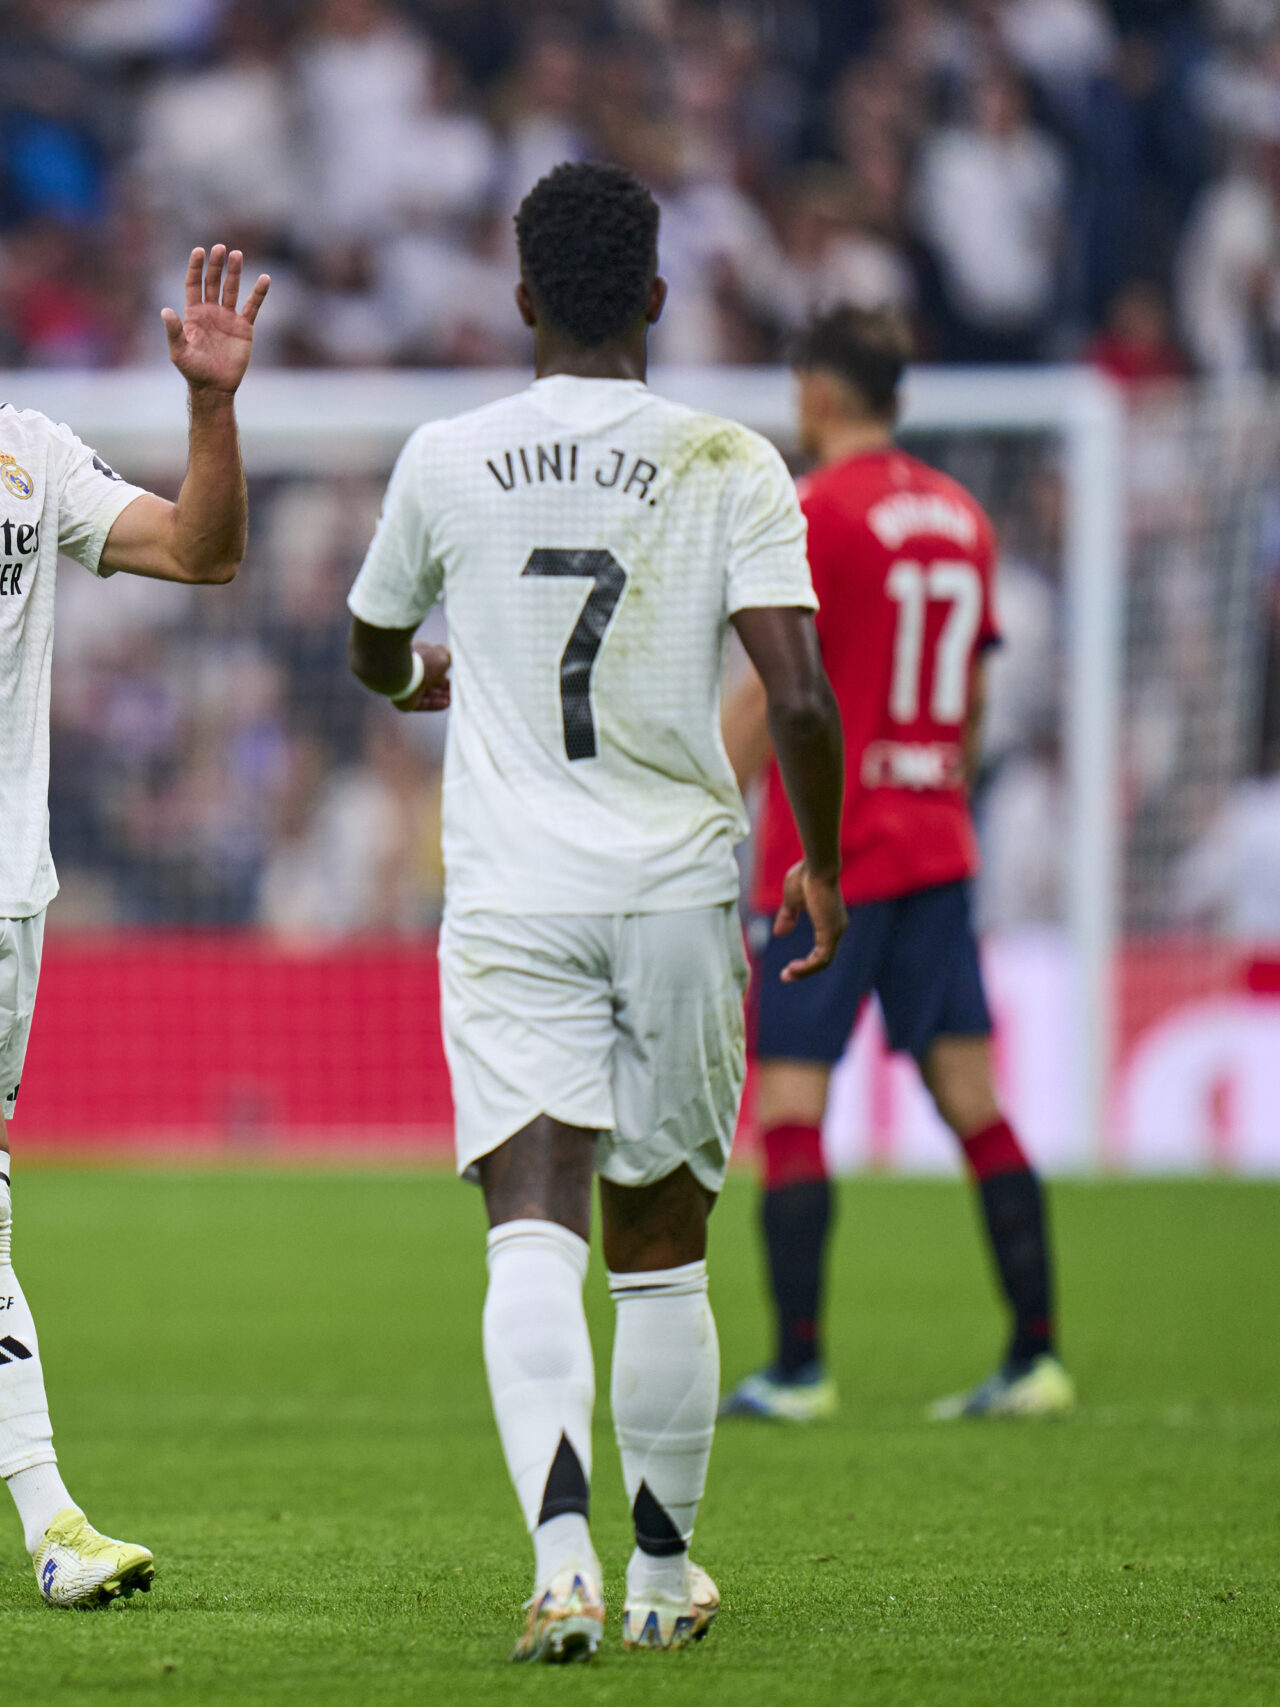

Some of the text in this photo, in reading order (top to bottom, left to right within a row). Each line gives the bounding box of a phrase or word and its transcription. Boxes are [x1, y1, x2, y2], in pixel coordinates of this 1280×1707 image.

[486, 443, 658, 507] VINI JR.
[521, 547, 629, 762] 7
[886, 557, 983, 724] 17
